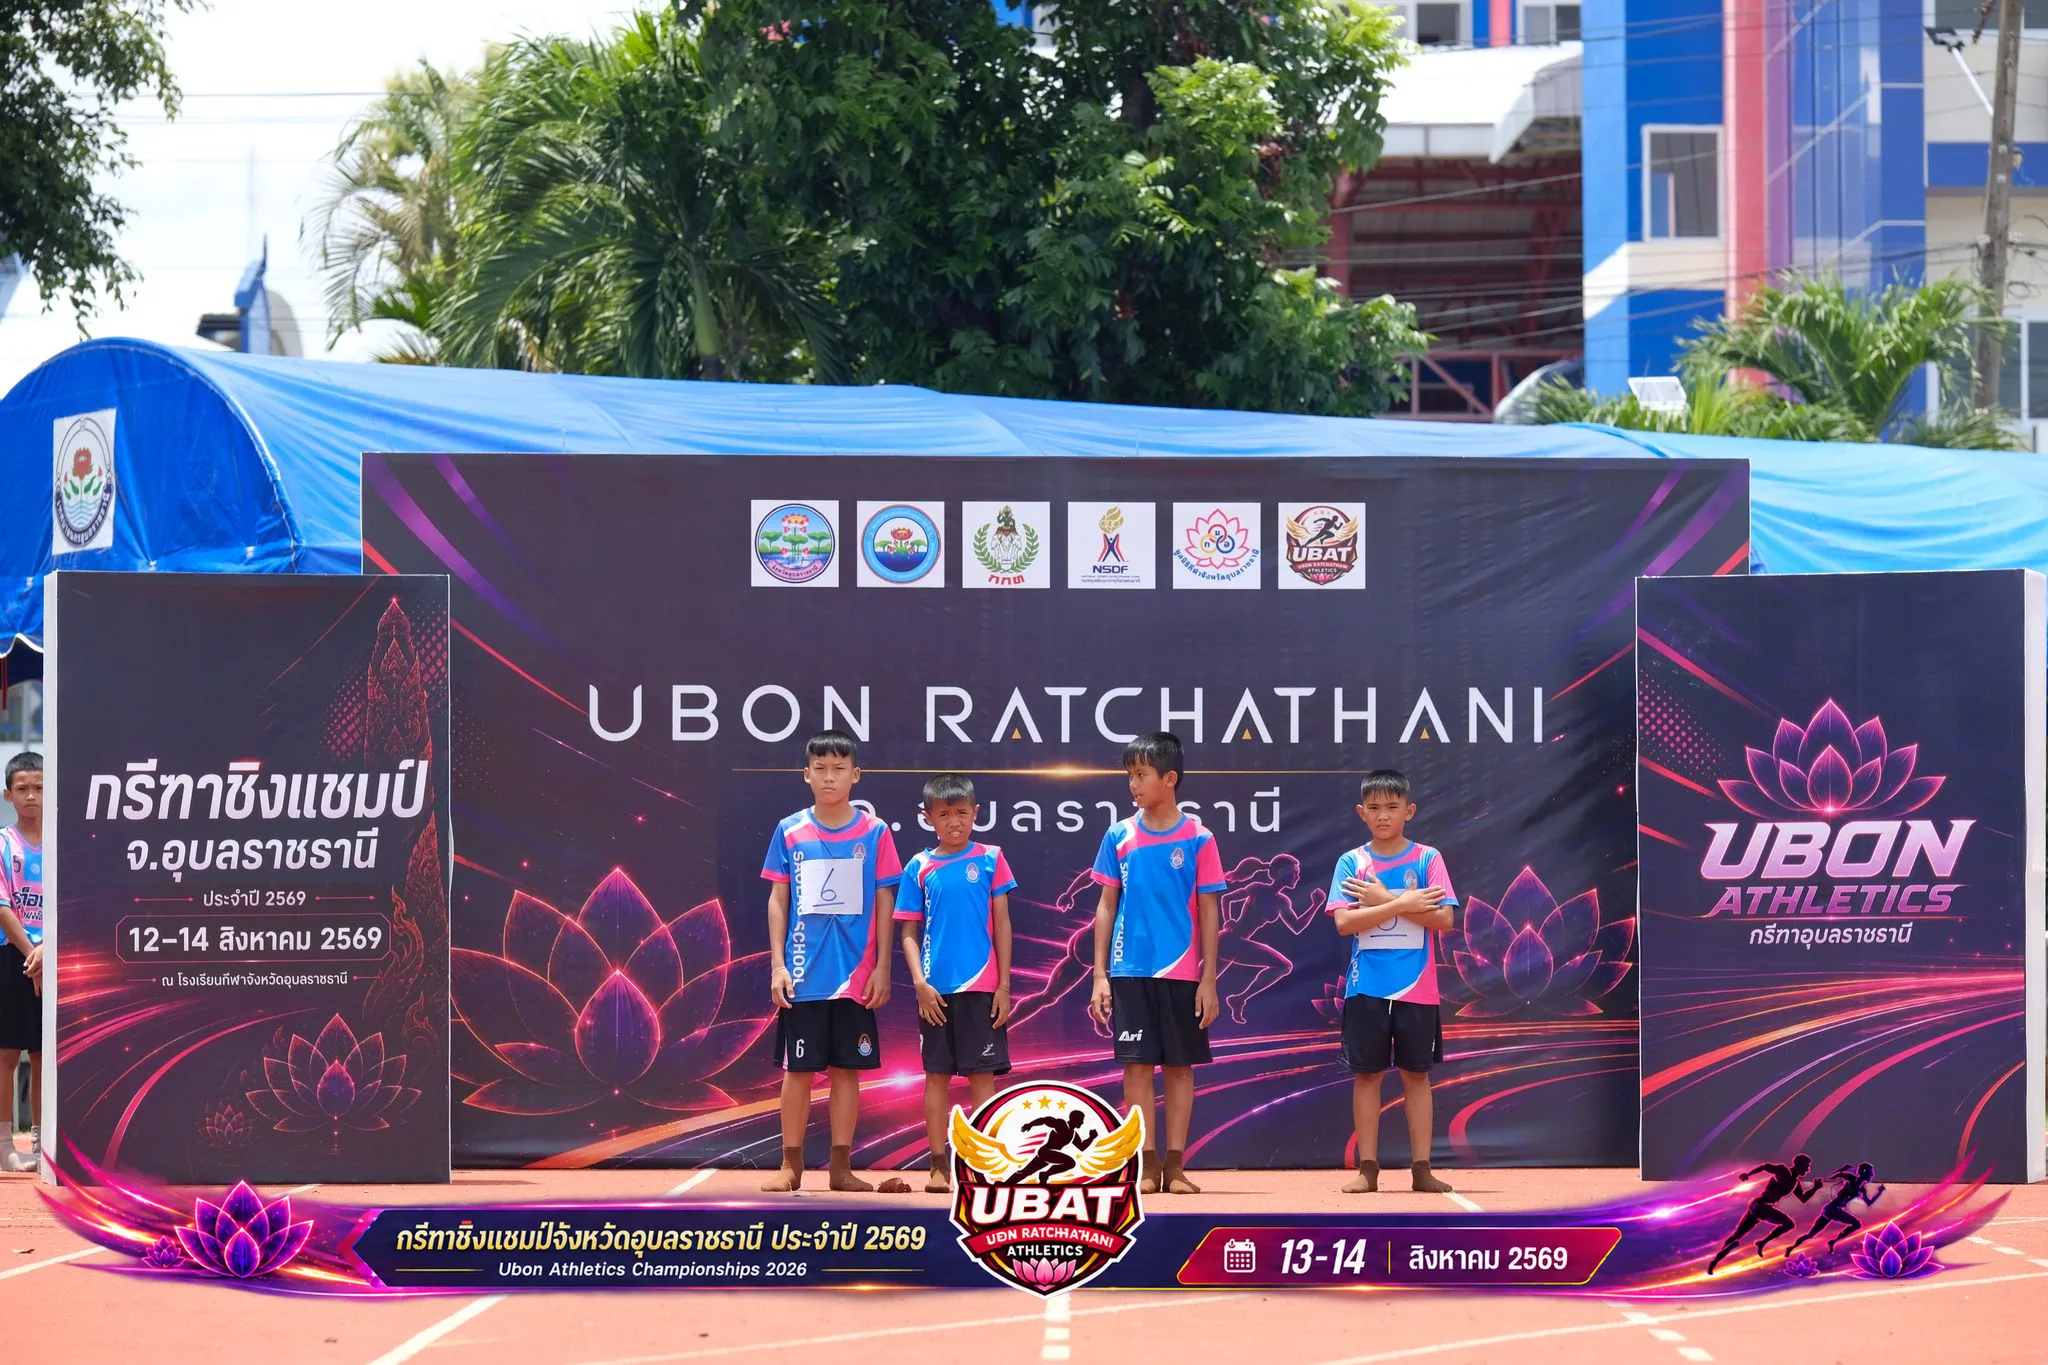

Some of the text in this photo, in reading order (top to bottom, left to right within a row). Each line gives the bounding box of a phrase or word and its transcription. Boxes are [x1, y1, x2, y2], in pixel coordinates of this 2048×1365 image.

[1292, 546, 1352, 562] UBAT
[1093, 565, 1128, 574] NSDF
[589, 684, 1543, 744] UBON RATCHATHANI
[85, 758, 429, 820] กรีฑาชิงแชมป์
[126, 827, 379, 883] จ.อุบลราชธานี
[1701, 820, 1977, 879] UBON
[203, 889, 306, 907] ประจำปี 2569
[820, 868, 837, 901] 6
[1704, 884, 1966, 917] ATHLETICS
[129, 925, 382, 952] 12-14 สิงหาคม 2569
[1749, 921, 1914, 950] กรีฑาอุบลราชธานี
[792, 921, 805, 987] SCHOOL
[161, 971, 348, 989] ณ โรงเรียนกีฬาจังหวัดอุบลราชธานี
[796, 1038, 805, 1058] 6
[1118, 1029, 1143, 1042] Ari
